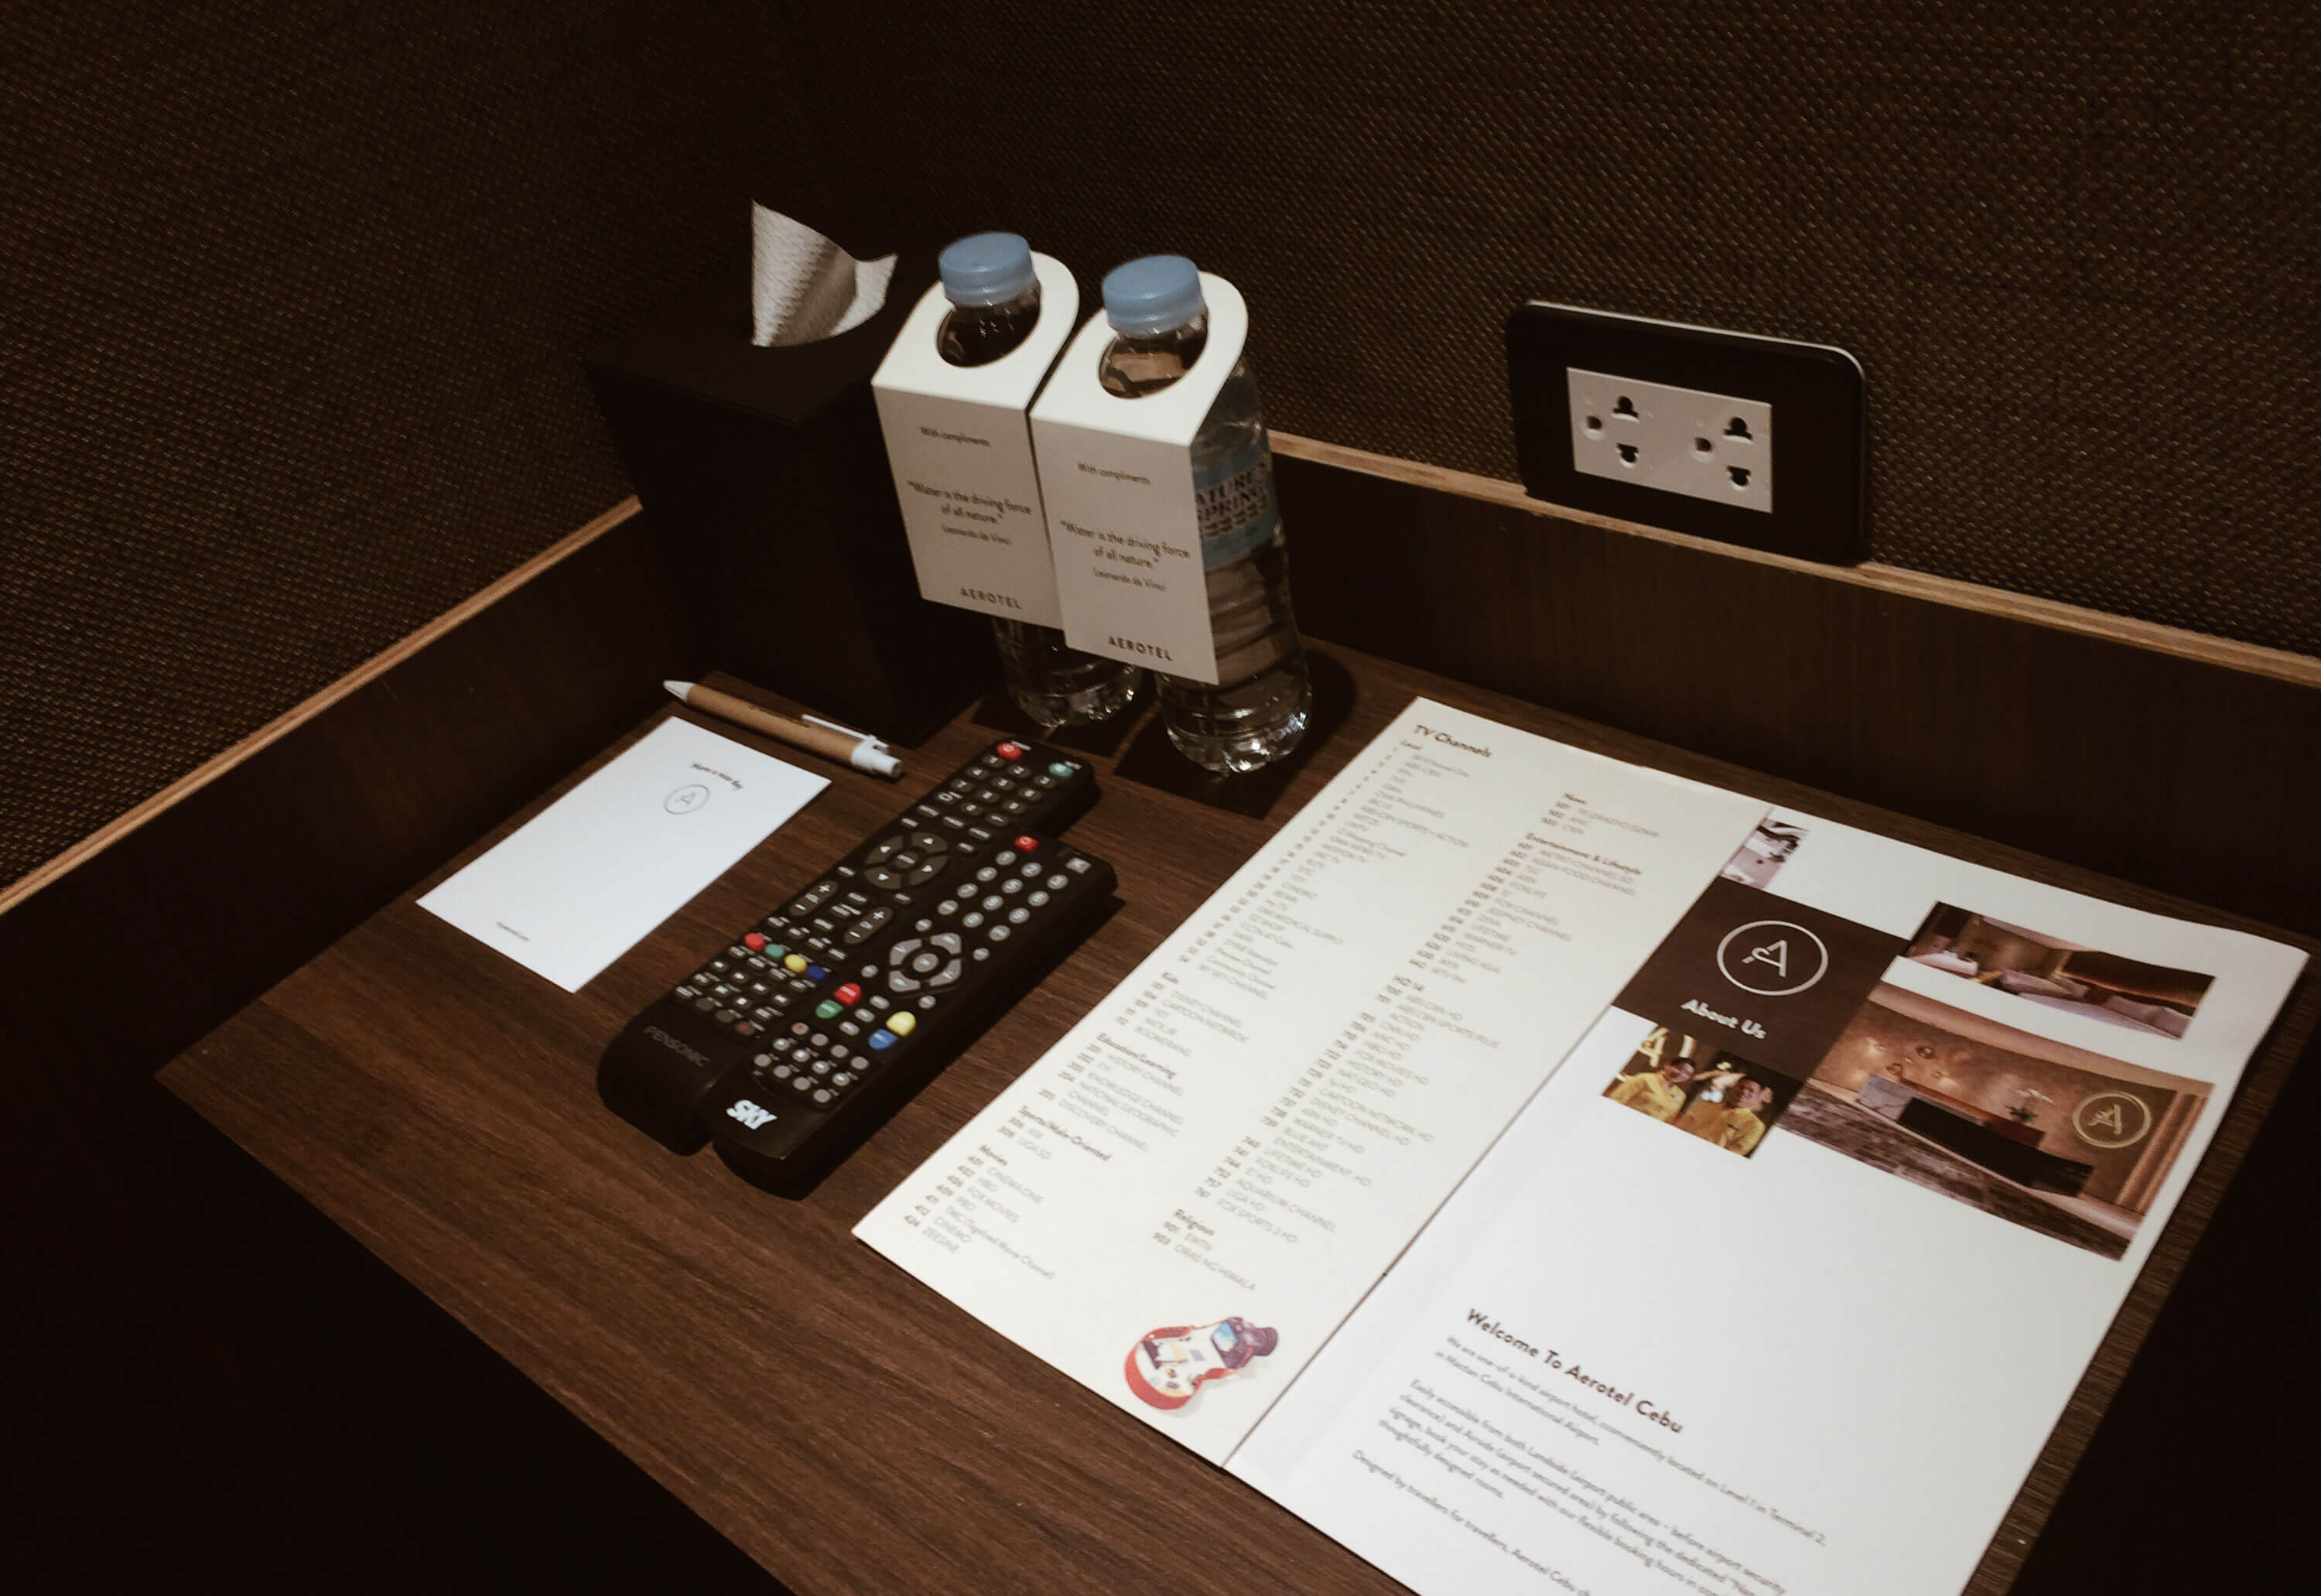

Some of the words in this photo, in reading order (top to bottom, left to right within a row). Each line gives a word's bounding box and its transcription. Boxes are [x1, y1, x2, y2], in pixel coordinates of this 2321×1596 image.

[940, 502, 952, 515] of
[952, 490, 969, 503] the
[970, 492, 1003, 514] driving
[1003, 497, 1033, 515] force
[1093, 545, 1104, 557] of
[1106, 531, 1123, 545] the
[1125, 535, 1160, 558] driving
[1161, 540, 1191, 559] force
[959, 586, 1022, 611] AEROTEL
[1107, 635, 1174, 662] AEROTEL
[1415, 725, 1434, 736] TV
[1434, 733, 1491, 757] Channels
[1681, 1000, 1738, 1028] About
[1742, 1020, 1766, 1038] Us
[726, 1099, 778, 1131] SKY
[1174, 1209, 1214, 1235] Religious
[1468, 1309, 1539, 1356] Welcome
[1545, 1350, 1561, 1369] To
[1565, 1365, 1634, 1405] Aerotel
[1636, 1400, 1682, 1433] Cebu
[1446, 1355, 1478, 1377] Mactan
[1480, 1374, 1504, 1392] Cebu
[1506, 1388, 1564, 1424] International
[1563, 1422, 1598, 1445] Airport.
[1410, 1379, 1435, 1399] Easily
[1437, 1397, 1479, 1423] accessible
[1482, 1420, 1504, 1437] from
[1504, 1434, 1526, 1451] both
[1527, 1447, 1569, 1475] Landside
[1605, 1494, 1637, 1514] public
[1639, 1512, 1660, 1526] area
[1671, 1528, 1705, 1550] before
[1706, 1549, 1742, 1570] airport
[1353, 1450, 1395, 1479] Designed
[1395, 1476, 1407, 1489] by
[1407, 1485, 1448, 1514] travellers
[1450, 1510, 1465, 1523] for
[1511, 1549, 1550, 1574] Aerotel
[1550, 1570, 1576, 1591] Cebu
[1770, 1509, 1816, 1538] Terminal
[1655, 1560, 1684, 1581] hours
